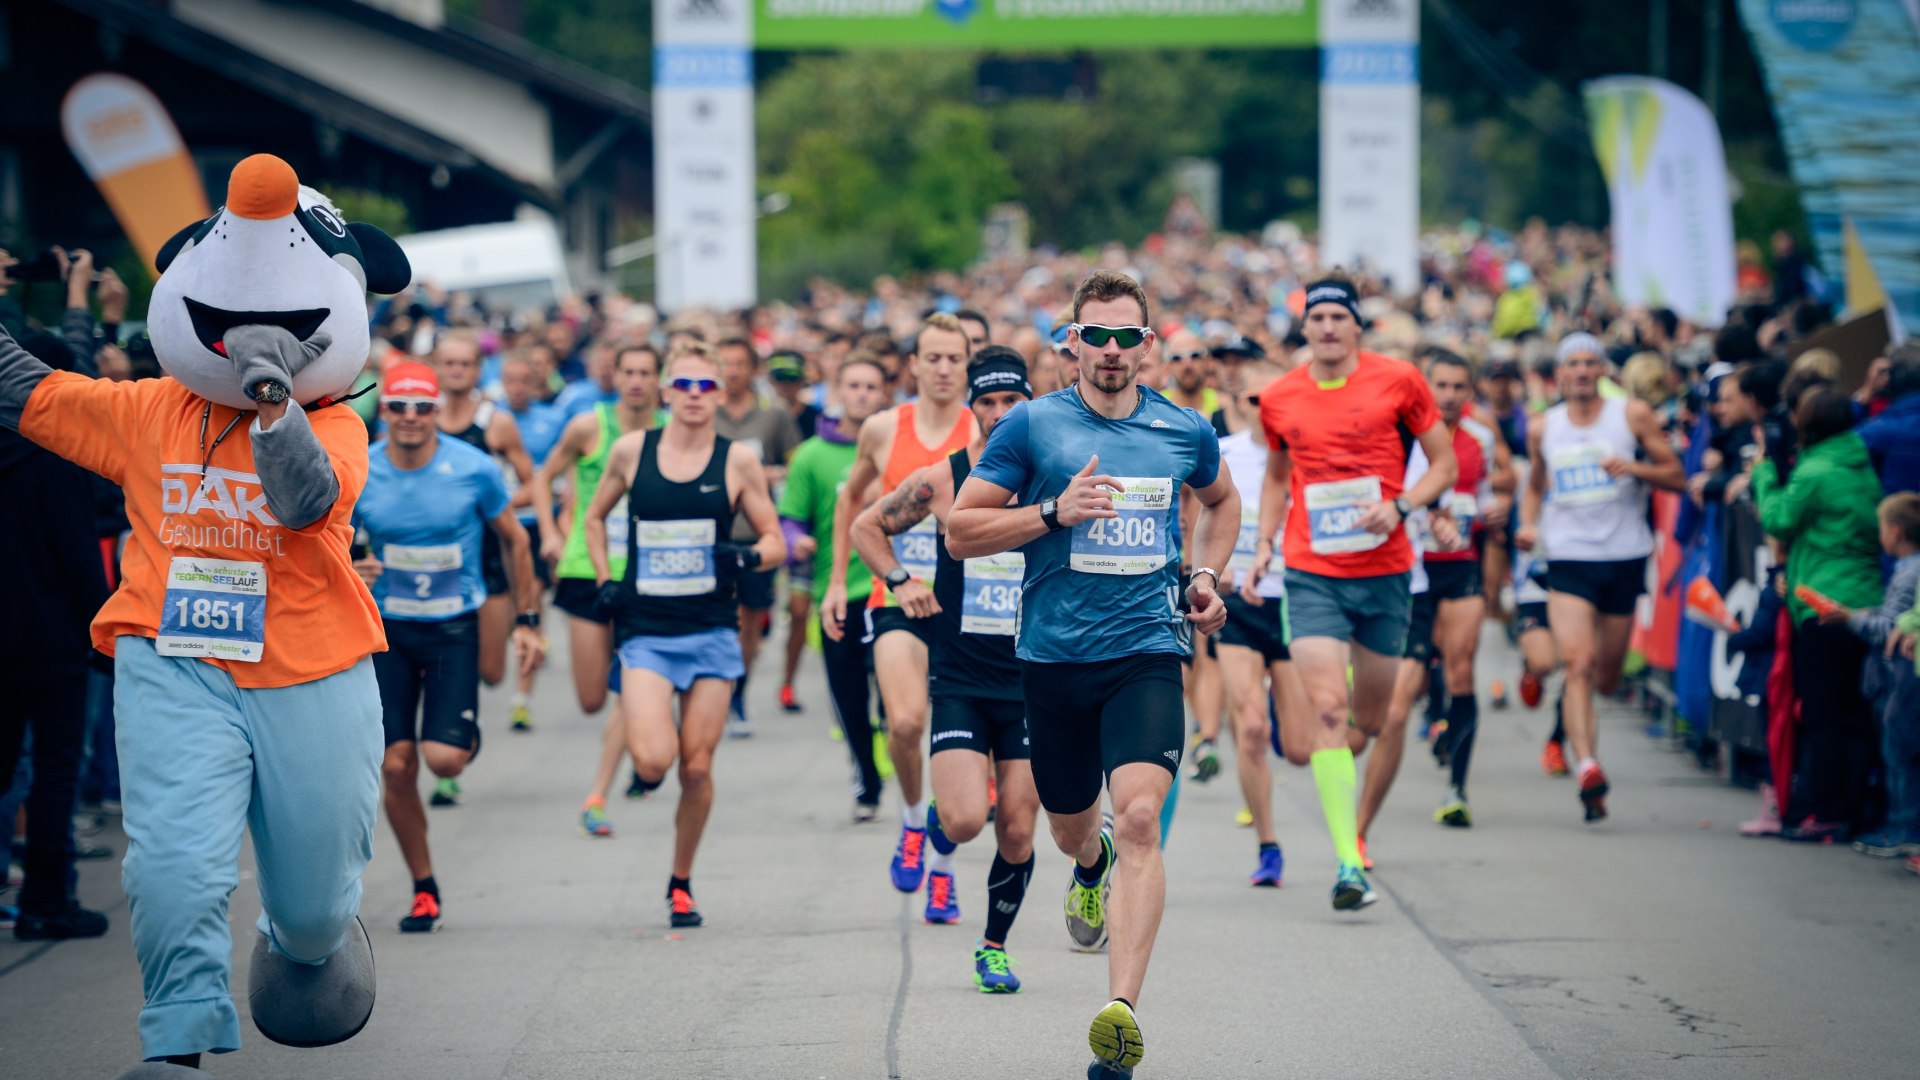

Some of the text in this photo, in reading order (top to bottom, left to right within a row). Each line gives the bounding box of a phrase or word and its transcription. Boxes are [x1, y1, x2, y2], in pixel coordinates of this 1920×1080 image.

[160, 464, 279, 526] DAK
[1111, 492, 1165, 503] RNSEELAUF
[1127, 484, 1158, 493] schuster
[1087, 516, 1156, 547] 4308
[1319, 506, 1367, 535] 430
[159, 516, 286, 556] Gesundheit
[175, 572, 258, 588] TEGERNSEELAUF
[213, 566, 250, 577] schuster
[414, 573, 432, 598] 2
[975, 584, 1022, 612] 430
[175, 597, 245, 632] 1851
